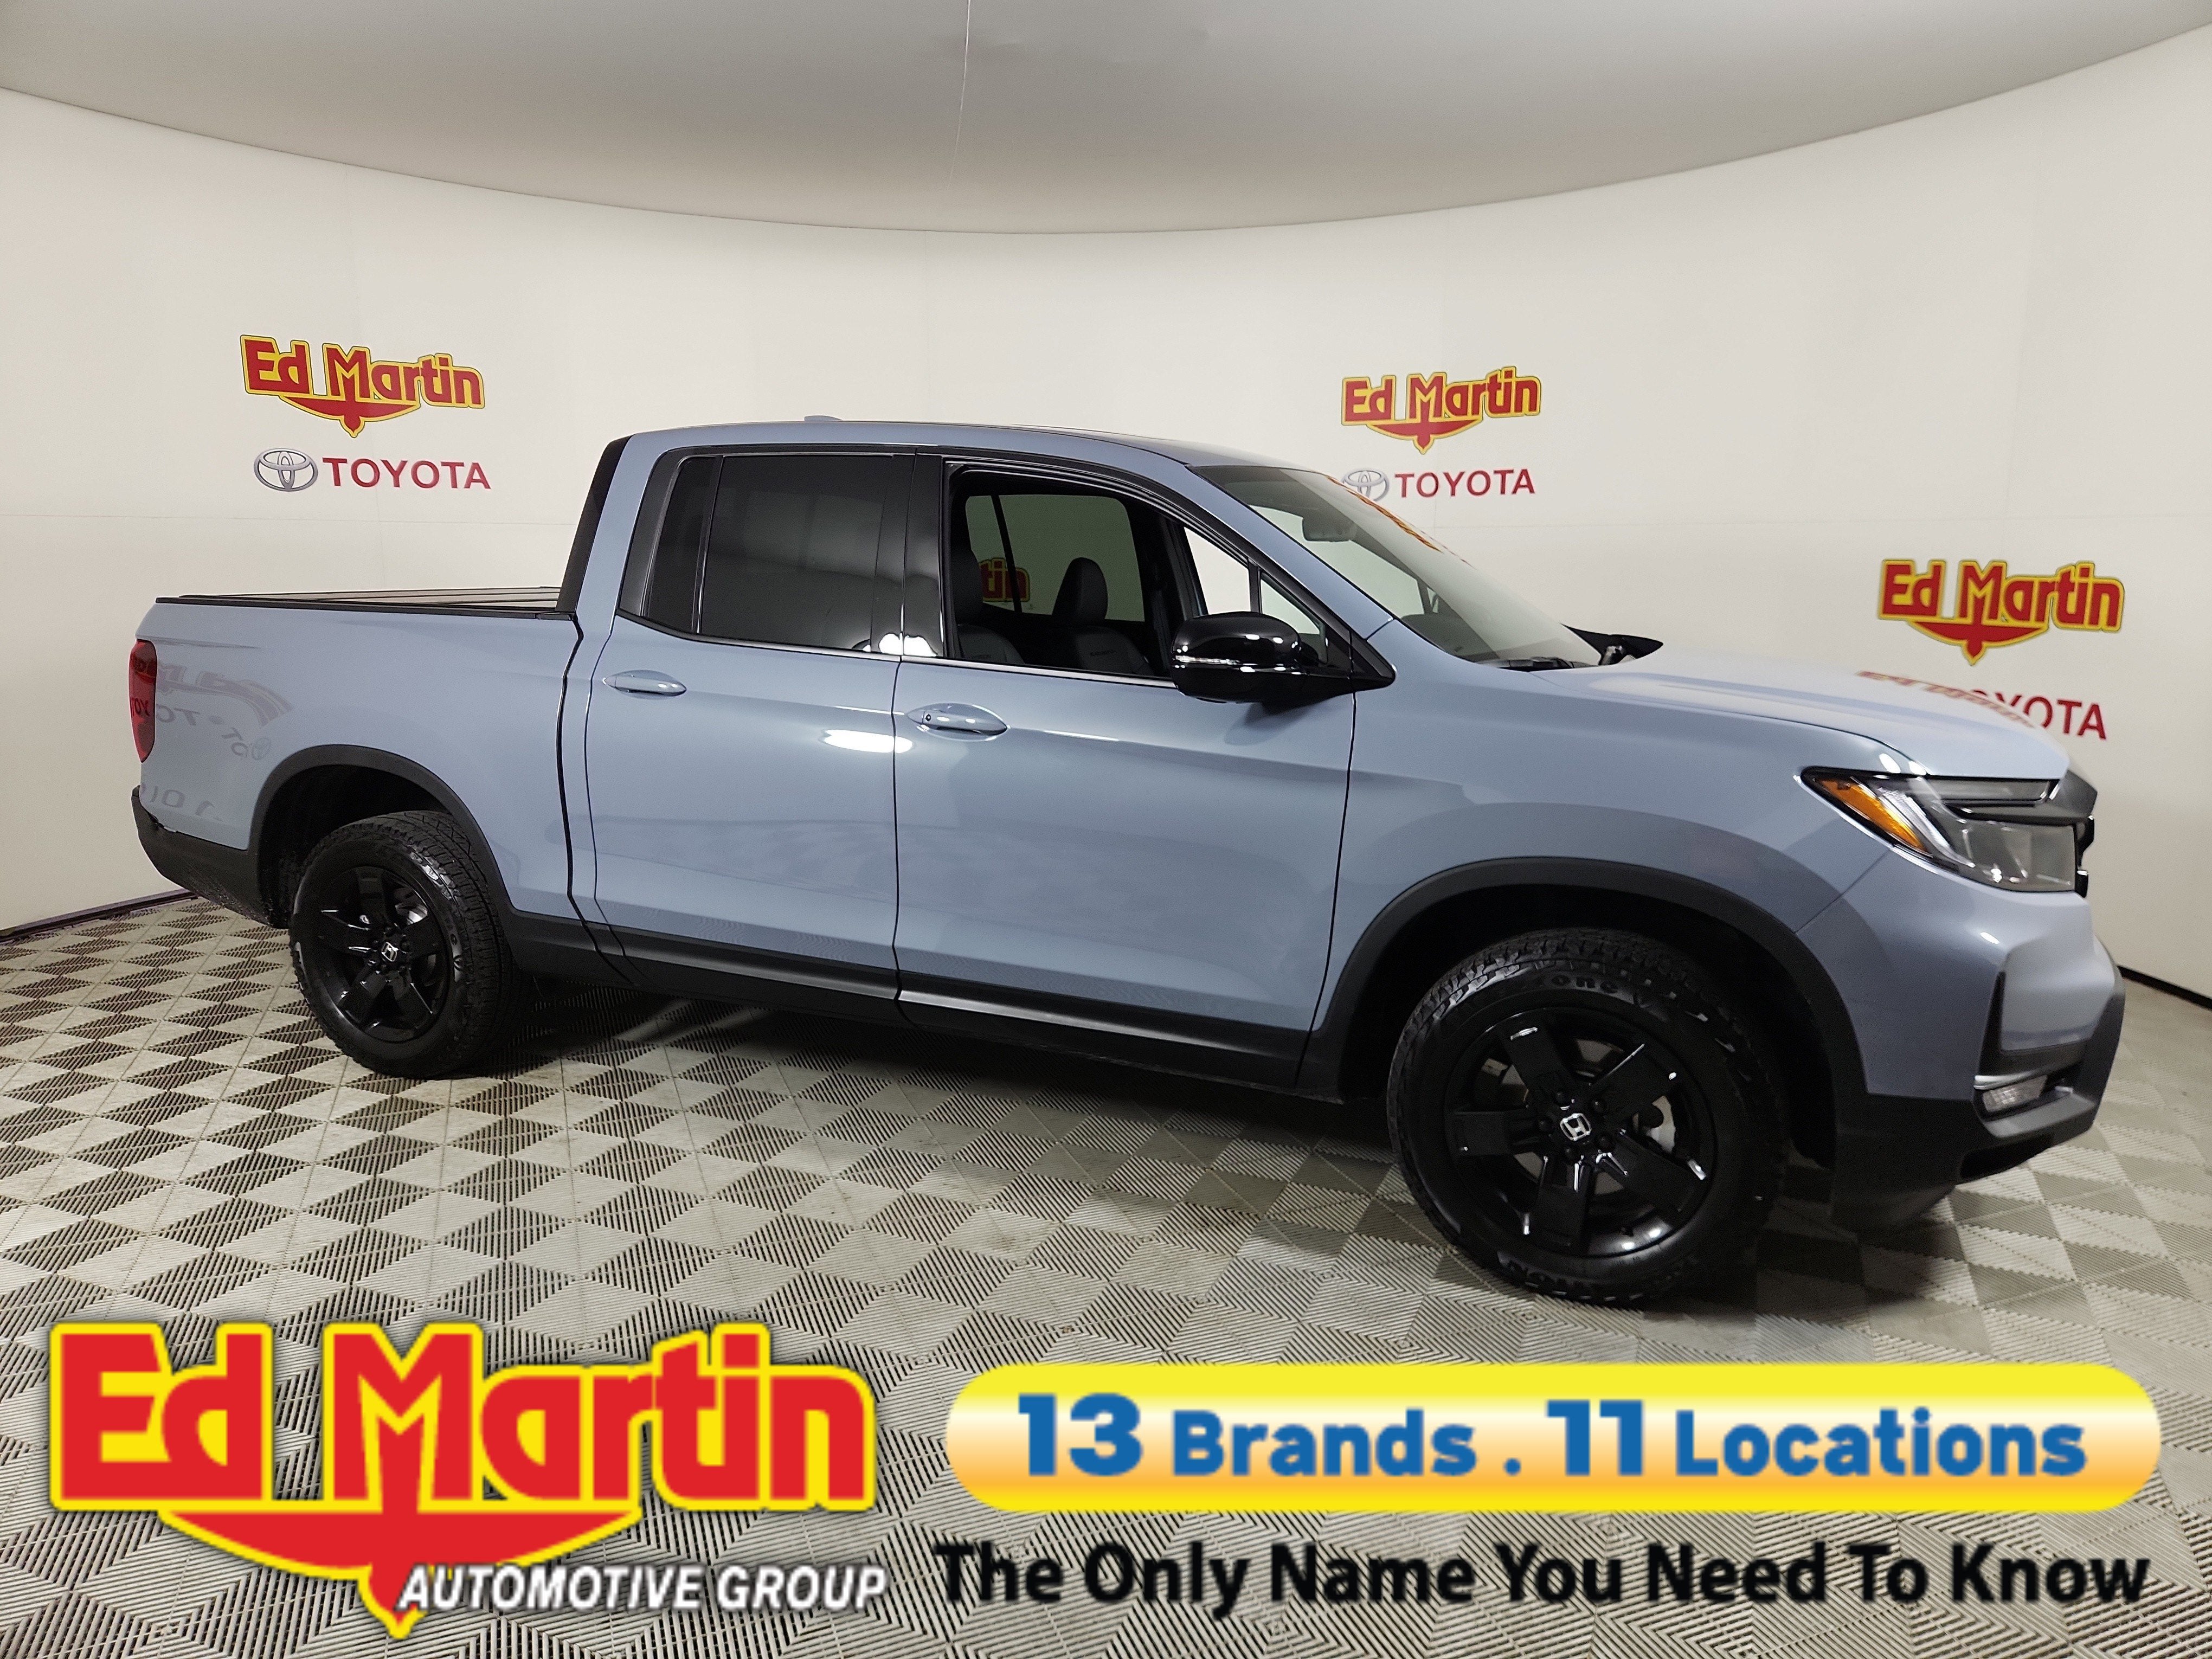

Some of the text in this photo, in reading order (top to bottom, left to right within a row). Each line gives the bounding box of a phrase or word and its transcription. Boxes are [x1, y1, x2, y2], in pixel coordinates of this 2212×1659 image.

[240, 335, 485, 410] Ed Martin
[1342, 366, 1541, 425] Ed Martin
[322, 457, 491, 489] TOYOTA
[1395, 468, 1535, 498] TOYOTA
[1878, 559, 2124, 632] Ed Martin
